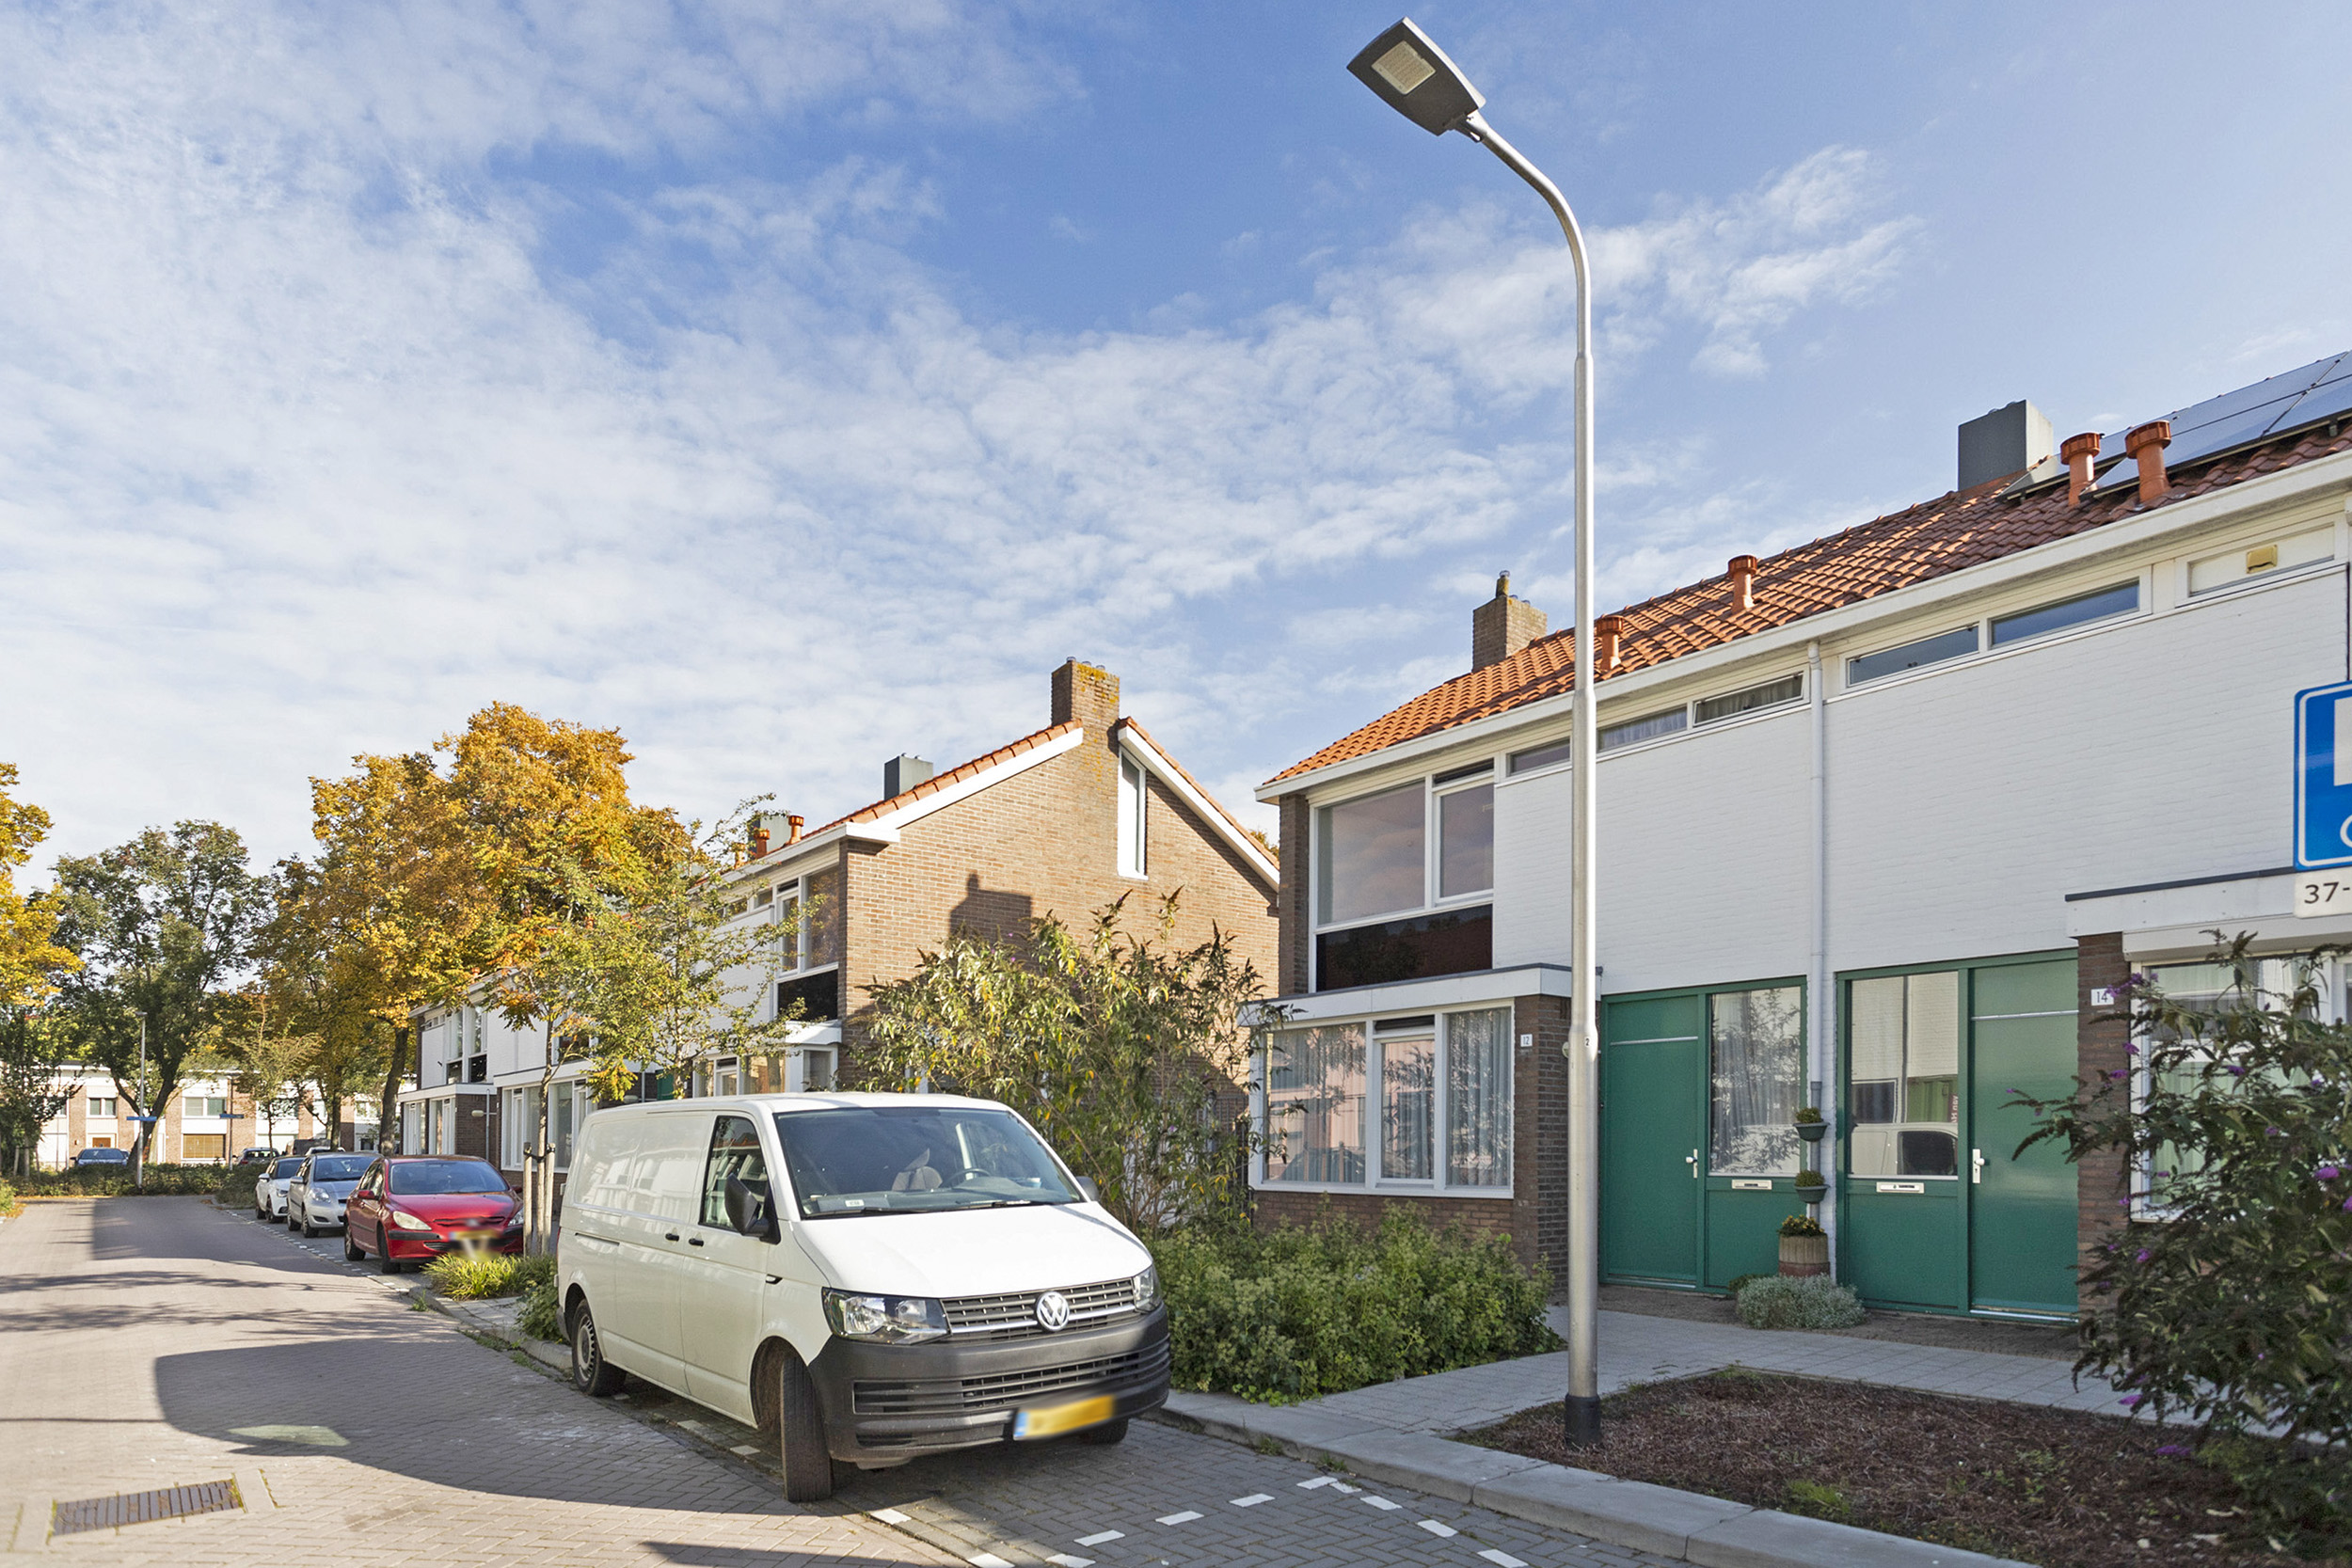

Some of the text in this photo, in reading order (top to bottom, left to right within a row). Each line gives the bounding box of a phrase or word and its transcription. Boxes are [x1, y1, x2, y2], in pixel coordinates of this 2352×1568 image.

[2304, 881, 2350, 904] 37-
[2096, 991, 2108, 1004] 14
[1522, 1036, 1530, 1045] 12
[1585, 1037, 1590, 1047] 2
